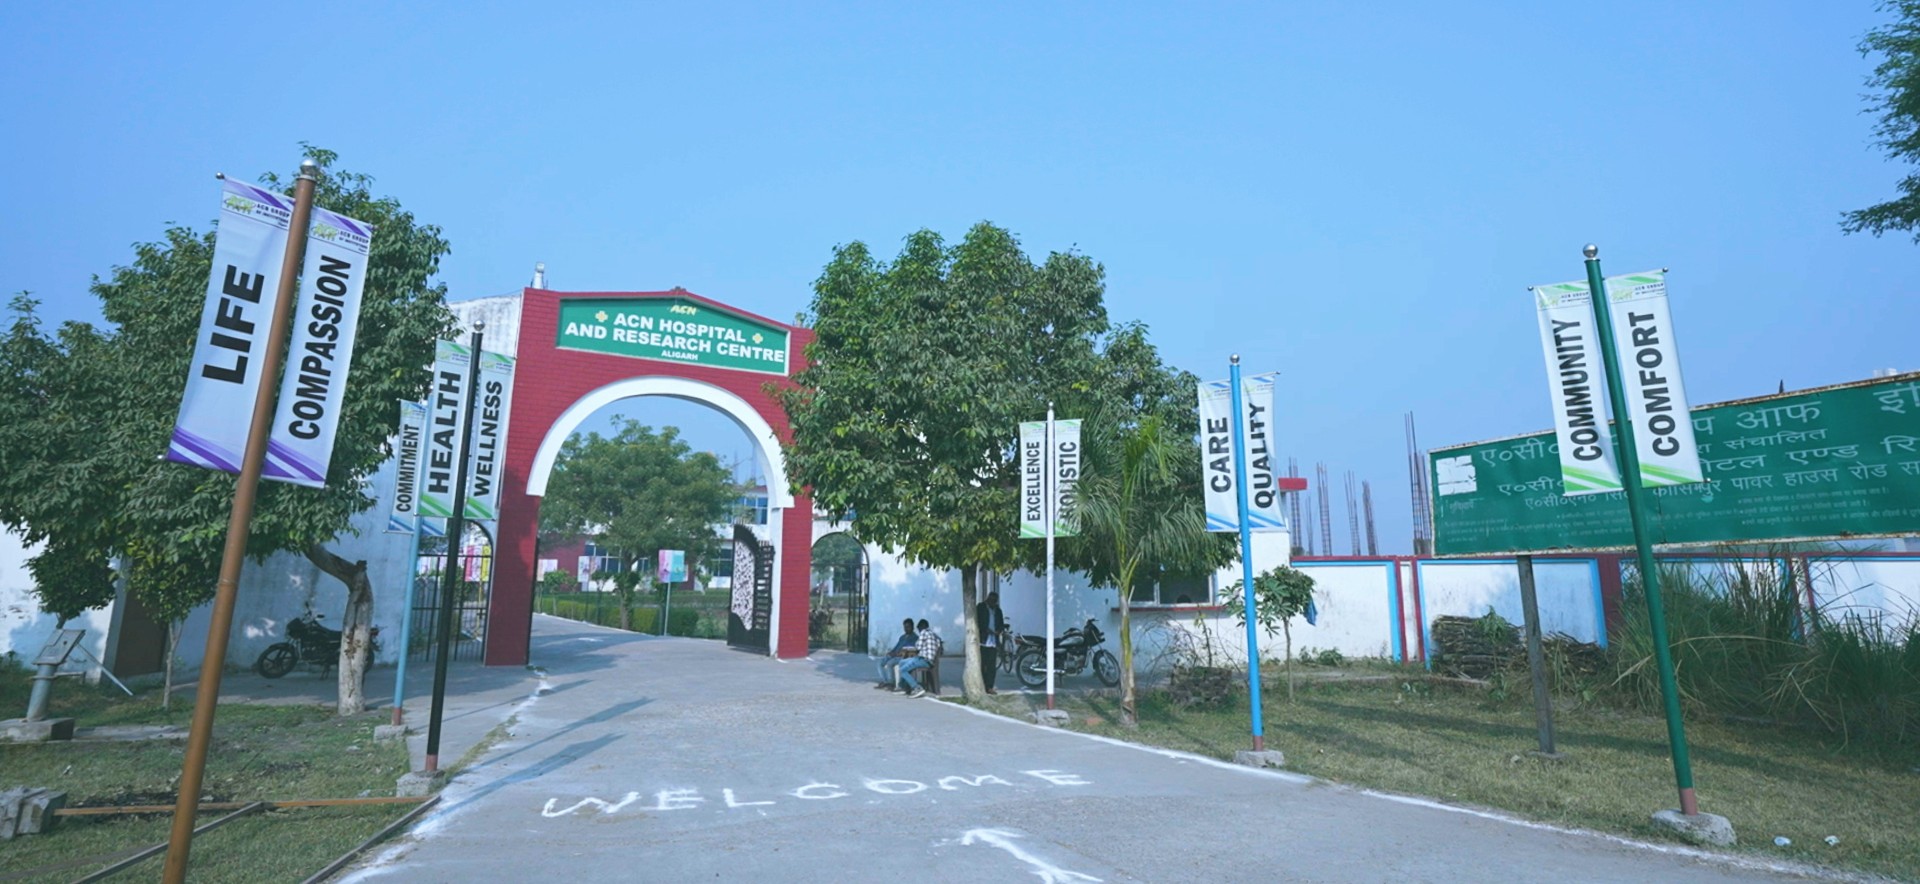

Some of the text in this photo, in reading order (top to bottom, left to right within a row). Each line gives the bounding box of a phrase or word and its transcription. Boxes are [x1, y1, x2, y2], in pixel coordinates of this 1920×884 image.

[201, 264, 265, 384] LIFE
[288, 255, 351, 440] COMPASSION
[565, 322, 784, 363] AND RESEARCH CENTRE
[613, 313, 746, 343] ACN HOSPITAL
[670, 304, 697, 316] ACN
[661, 349, 698, 361] ALIGARH
[1552, 319, 1603, 462] COMMUNITY
[1628, 311, 1681, 456] COMFORT
[395, 424, 420, 512] COMMITMENT
[428, 371, 461, 494] HEALTH
[473, 380, 503, 498] WELLNESS
[1207, 417, 1232, 493] CARE
[1249, 402, 1276, 509] QUALITY
[1848, 461, 1888, 480] रोड
[1026, 441, 1041, 522] EXCELLENCE
[541, 769, 1095, 818] WELCOME
